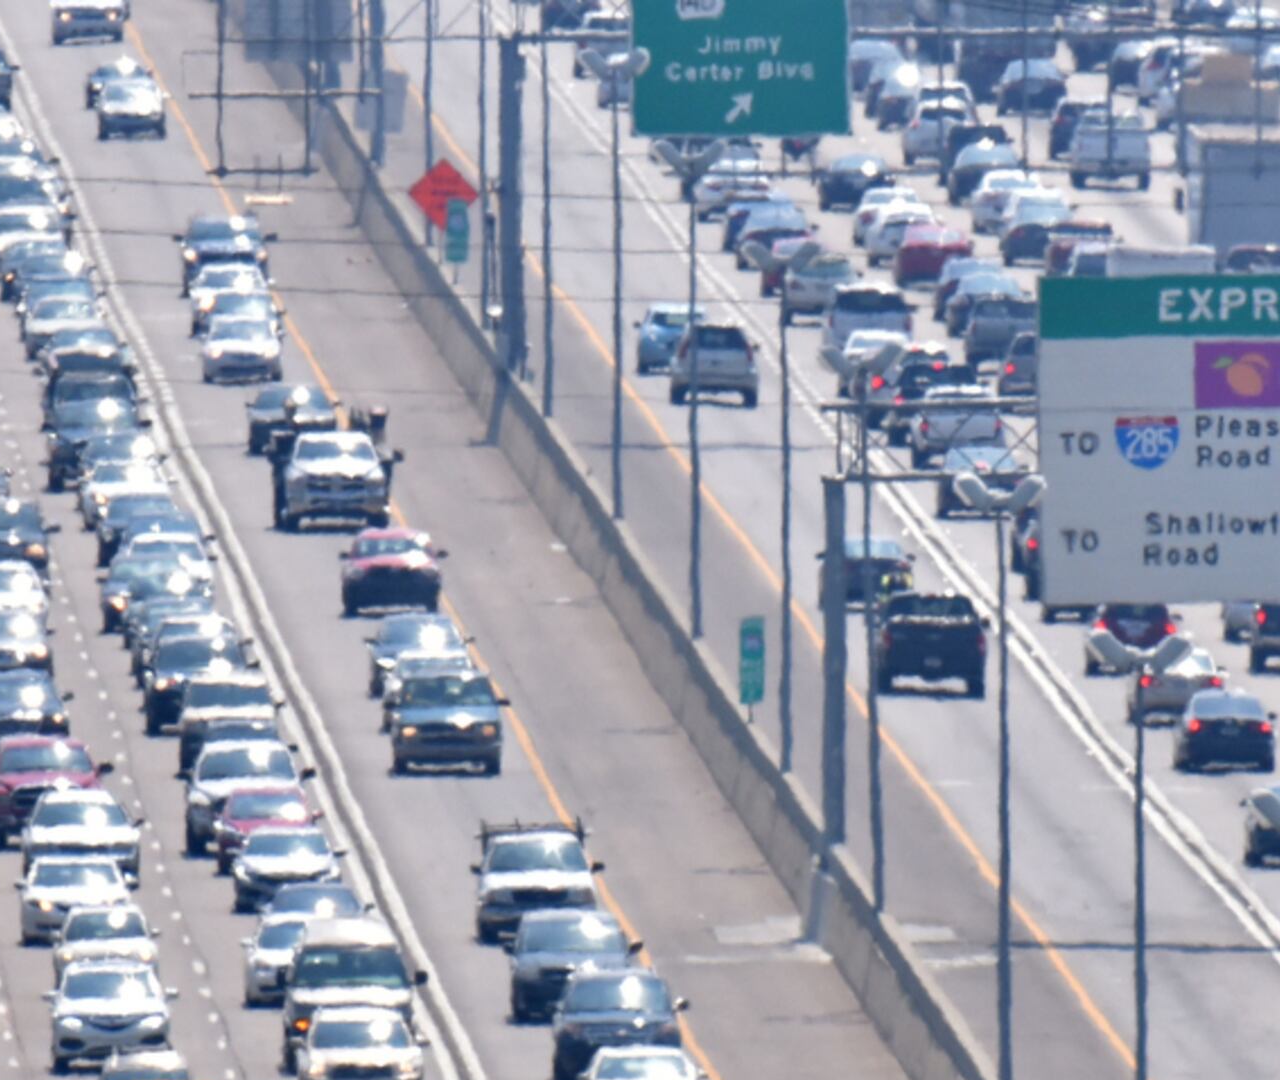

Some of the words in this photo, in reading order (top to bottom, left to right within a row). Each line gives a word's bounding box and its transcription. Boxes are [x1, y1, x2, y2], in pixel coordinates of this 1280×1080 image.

[698, 36, 783, 54] Jimmy
[664, 61, 743, 82] Carter
[757, 60, 815, 81] Blvd
[1060, 432, 1099, 456] TO
[1126, 427, 1175, 459] 285
[1195, 445, 1271, 468] Road
[1060, 530, 1099, 553] TO
[1143, 542, 1219, 567] Road
